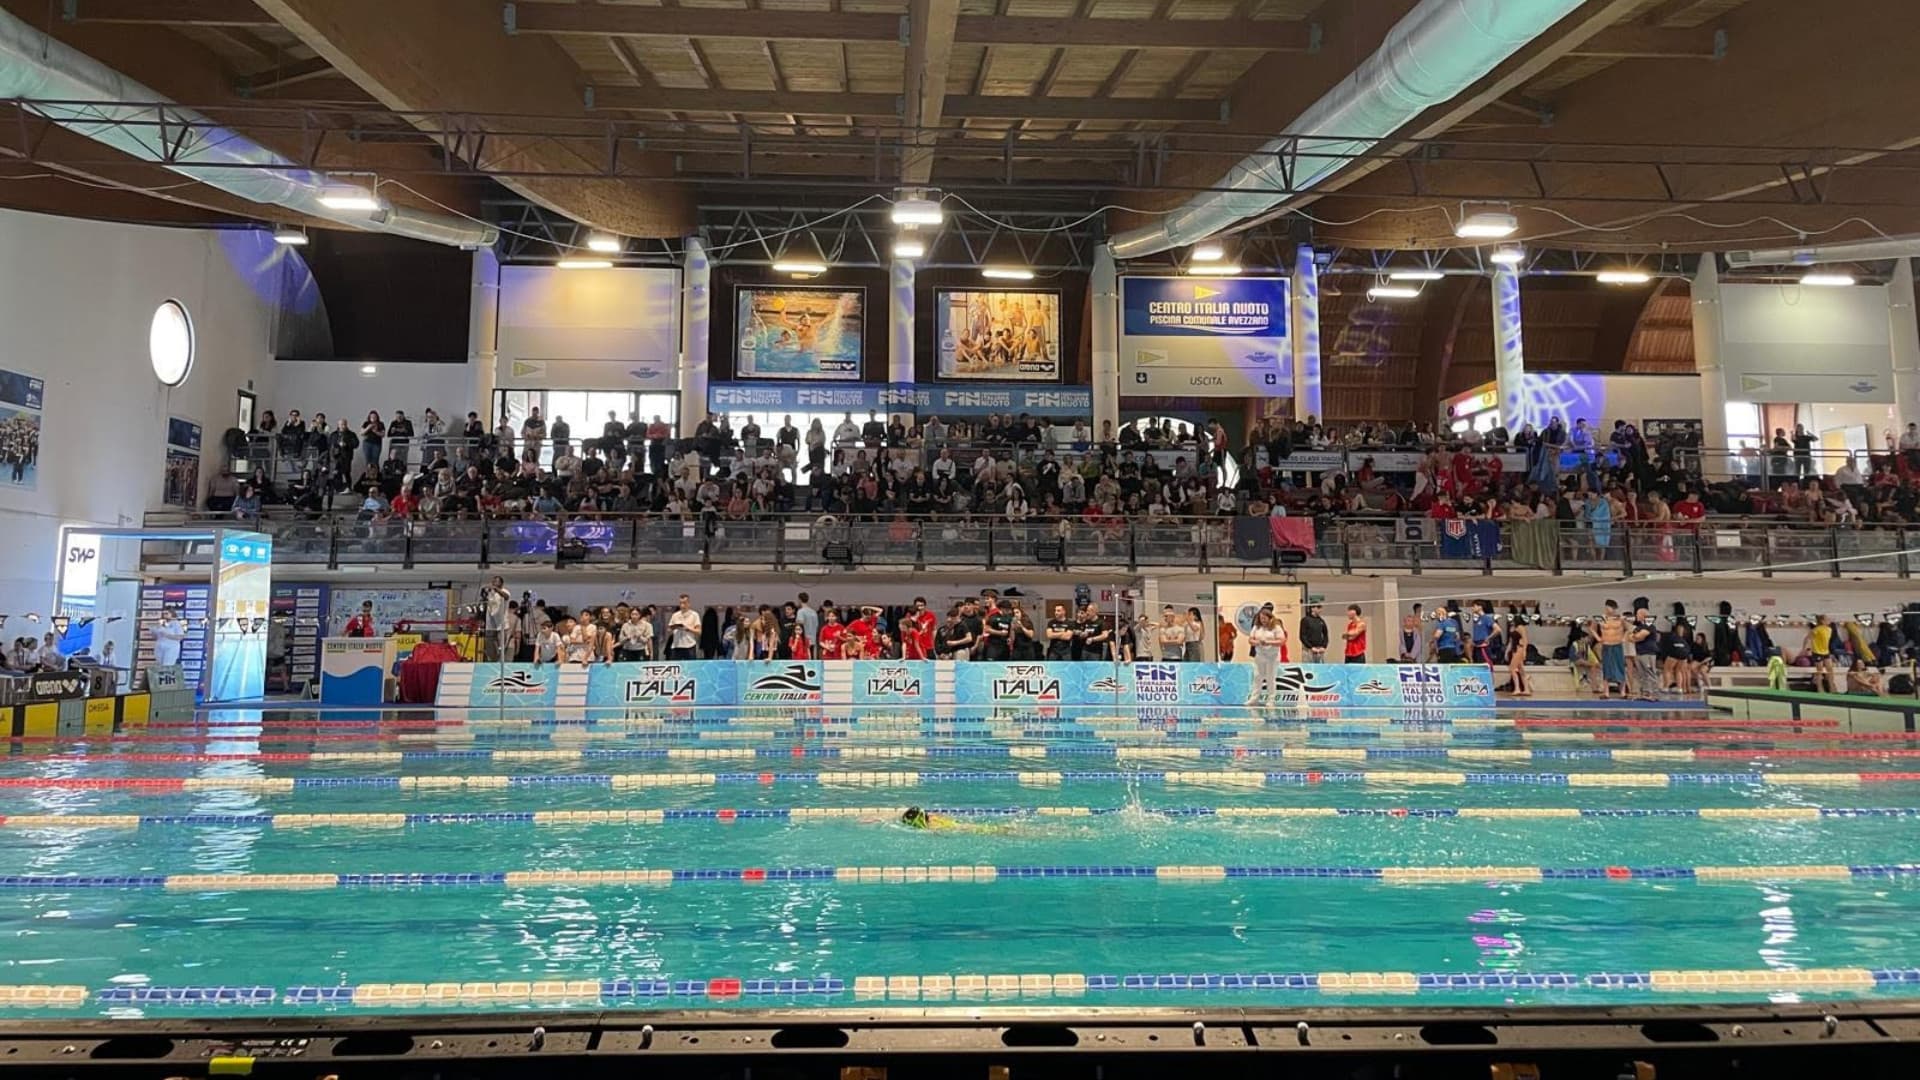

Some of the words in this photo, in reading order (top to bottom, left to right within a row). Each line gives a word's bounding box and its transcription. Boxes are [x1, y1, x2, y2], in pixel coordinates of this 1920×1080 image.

[1149, 302, 1191, 314] CENTRO
[1194, 302, 1230, 315] ITALIA
[1233, 302, 1269, 315] NUOTO
[1150, 316, 1182, 325] PISCINA
[1183, 316, 1227, 325] COMUNALE
[1228, 316, 1269, 326] AVEZZANO
[1190, 376, 1223, 386] USCITA
[715, 389, 751, 404] FIN
[797, 390, 833, 405] FIN
[945, 391, 980, 407] FIN
[1025, 391, 1060, 407] FIN
[1135, 665, 1177, 681] FIN
[1399, 666, 1441, 682] FIN
[35, 680, 63, 695] arena
[94, 676, 103, 690] 8
[626, 679, 695, 701] ITALIA
[868, 679, 920, 695] ITALIA
[994, 679, 1060, 700] ITALIA
[744, 693, 779, 701] CENTRO
[780, 693, 808, 701] ITALIA
[1136, 693, 1178, 702] NUOTO
[1310, 694, 1340, 702] NUOTO
